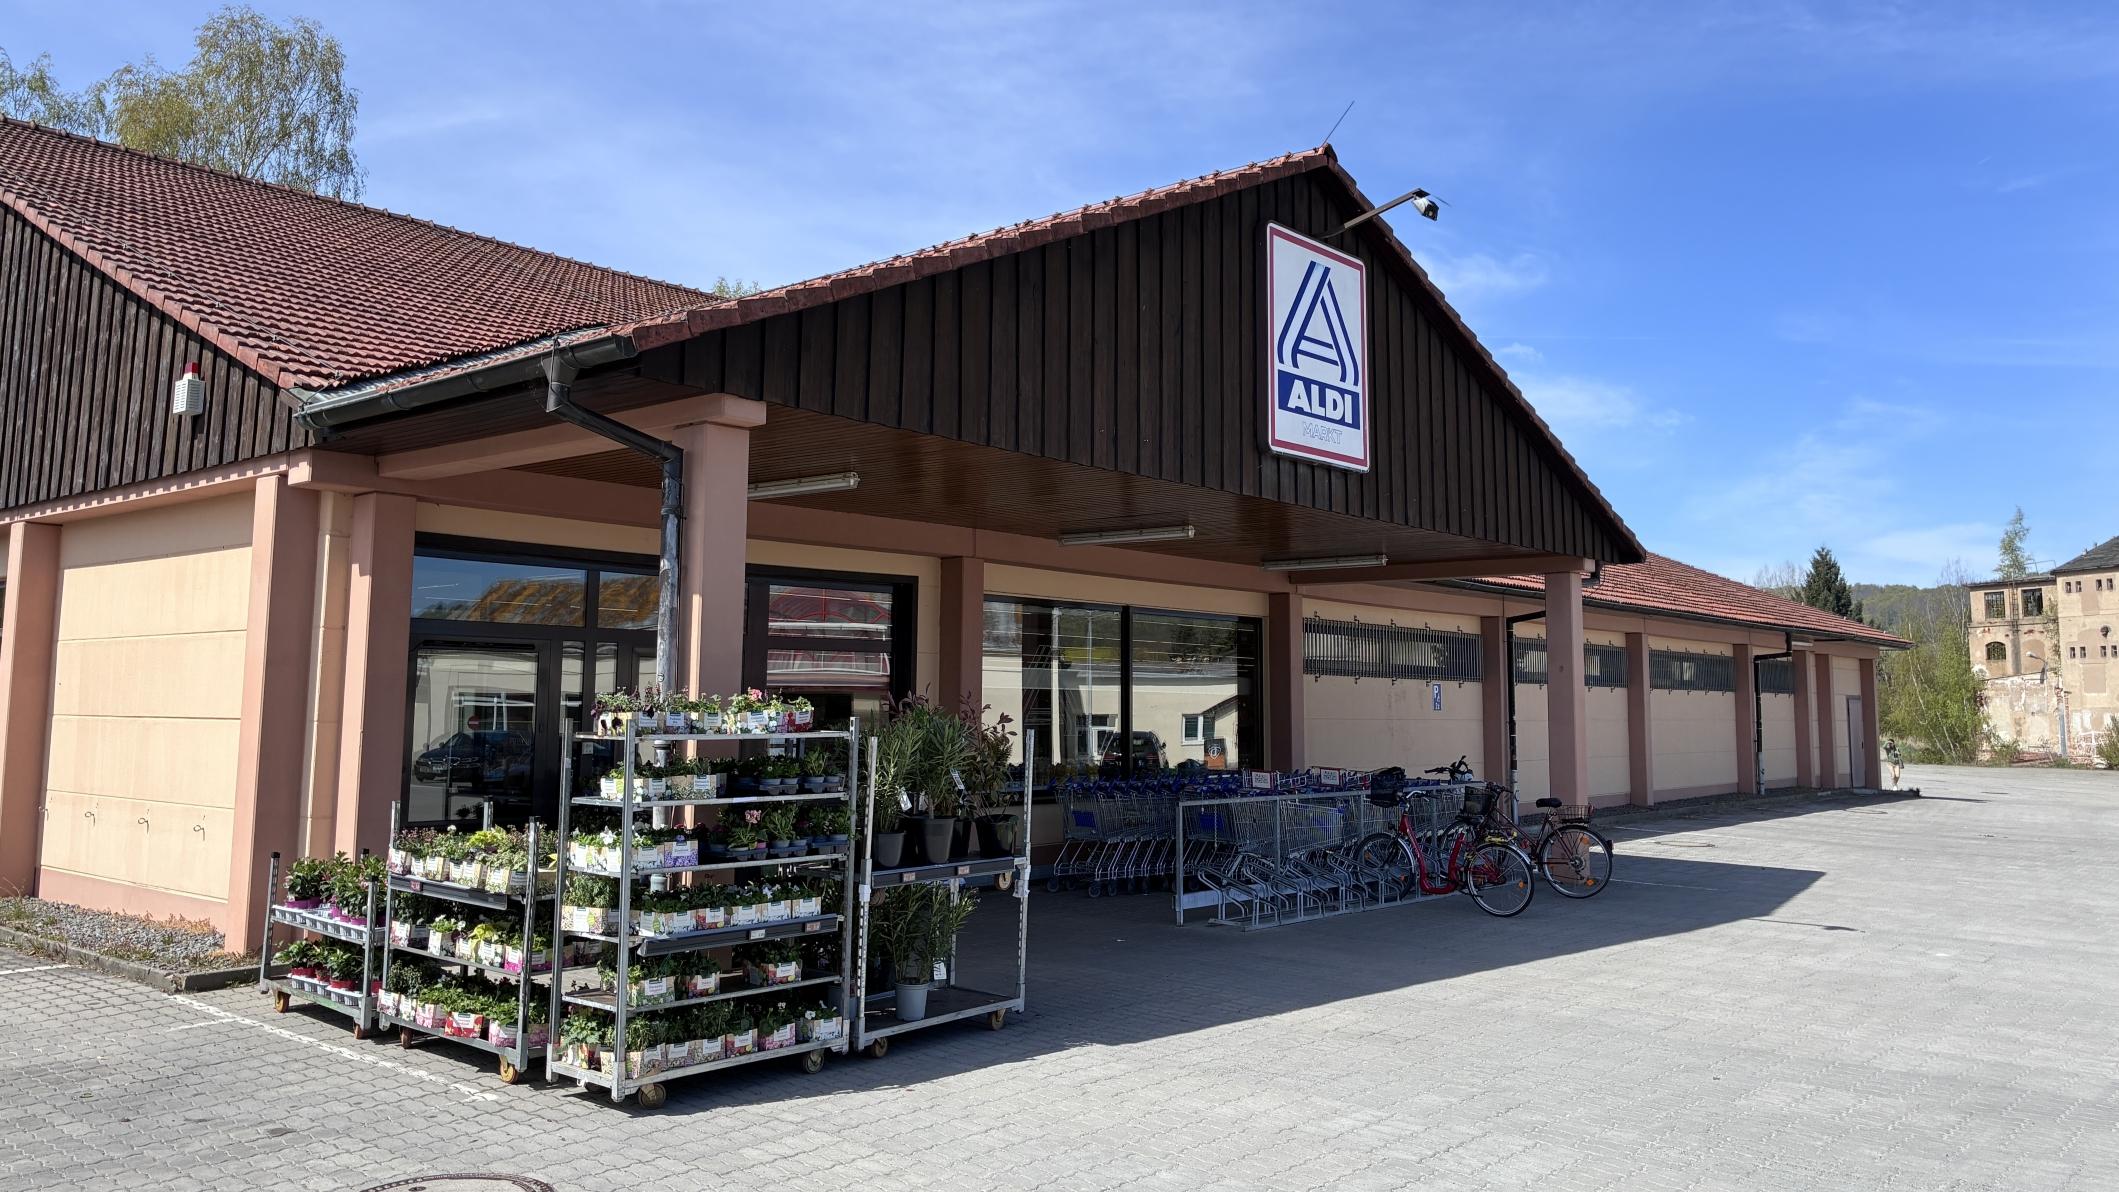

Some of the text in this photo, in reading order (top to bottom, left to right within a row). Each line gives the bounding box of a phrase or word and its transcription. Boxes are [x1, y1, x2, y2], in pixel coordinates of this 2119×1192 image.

[1287, 379, 1353, 424] ALDI
[1302, 421, 1343, 445] MARKT
[1433, 685, 1439, 698] P
